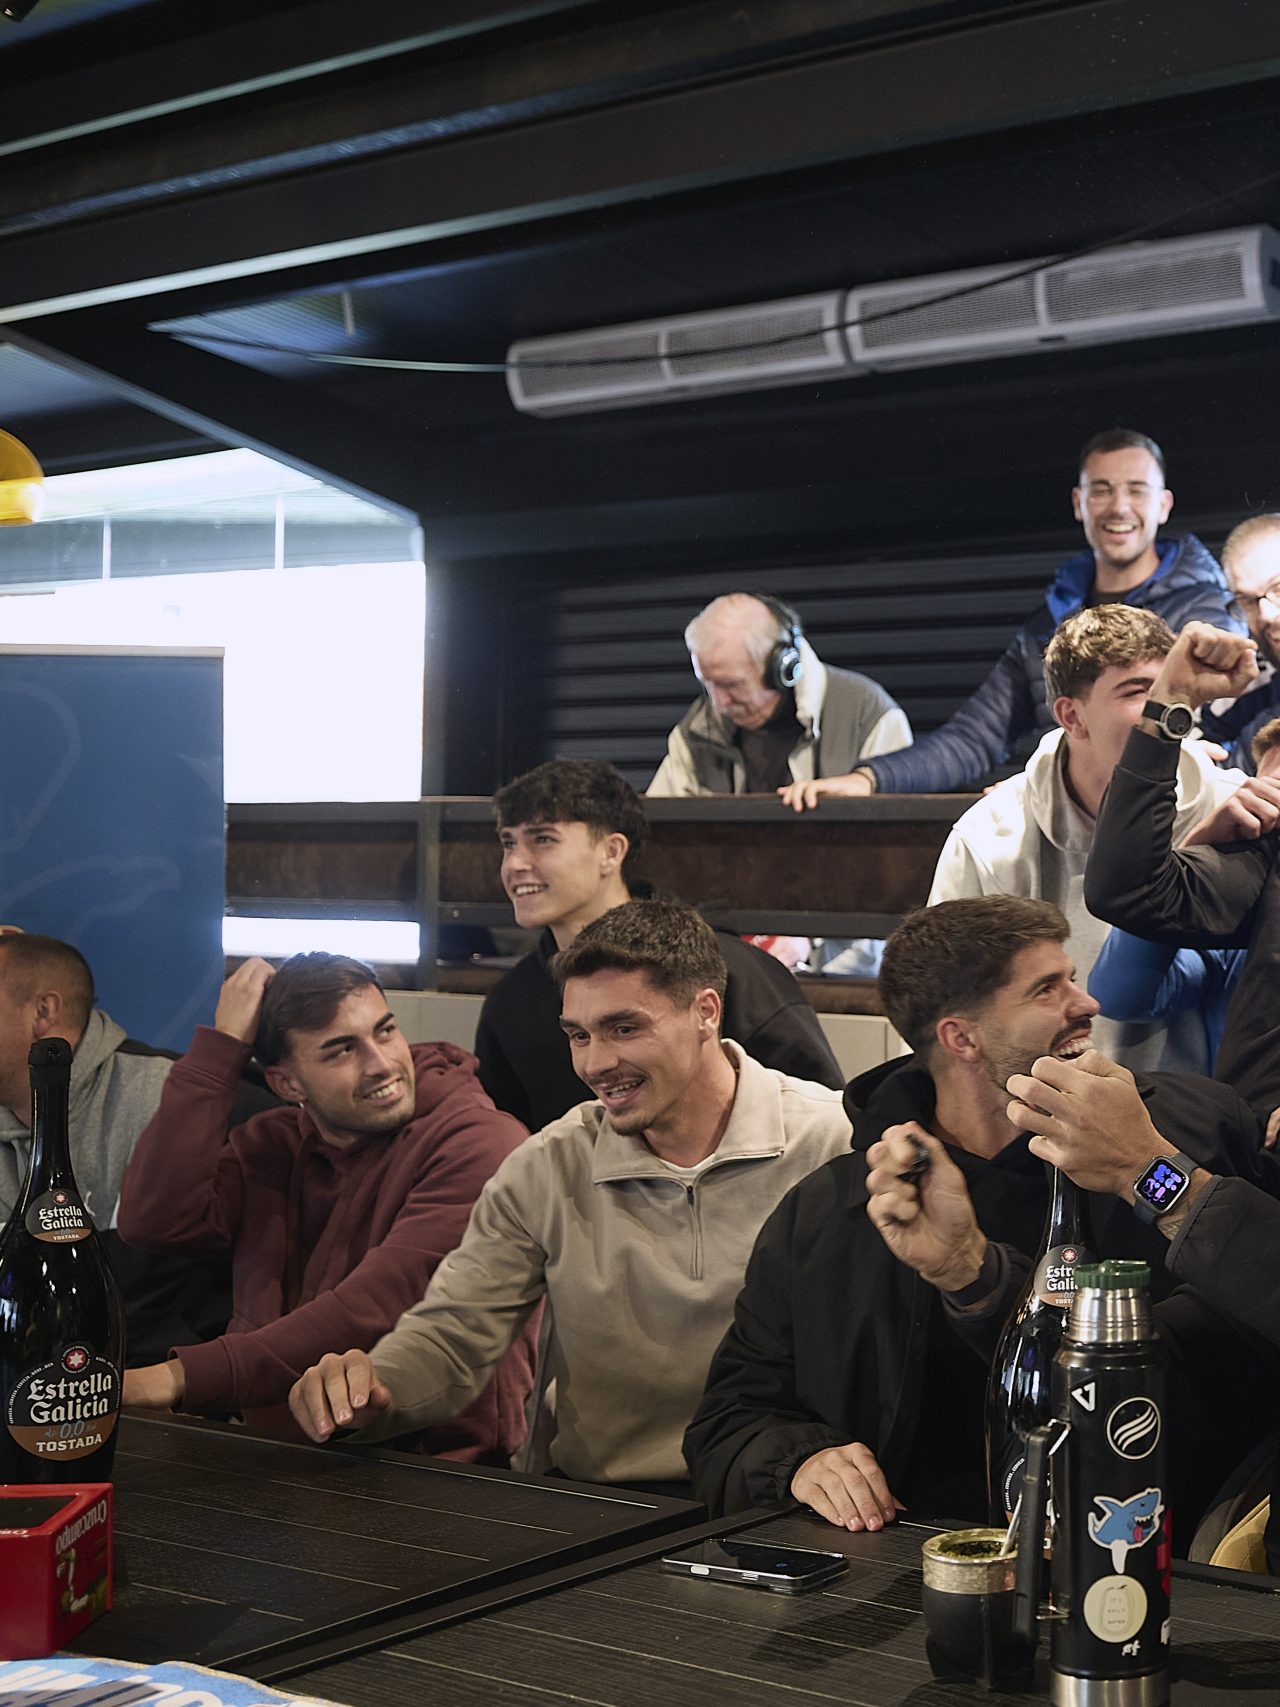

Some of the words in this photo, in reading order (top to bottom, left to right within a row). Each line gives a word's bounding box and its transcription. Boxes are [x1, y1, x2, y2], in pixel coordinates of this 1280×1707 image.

[39, 1206, 82, 1220] Estrella
[41, 1217, 84, 1230] Galicia
[1046, 1265, 1073, 1279] Estr
[1047, 1278, 1078, 1291] Gali
[27, 1373, 112, 1400] Estrella
[30, 1395, 108, 1424] Galicia
[60, 1420, 84, 1439] 0,0
[36, 1434, 102, 1452] TOSTADA
[56, 1500, 107, 1555] Cruzcampo
